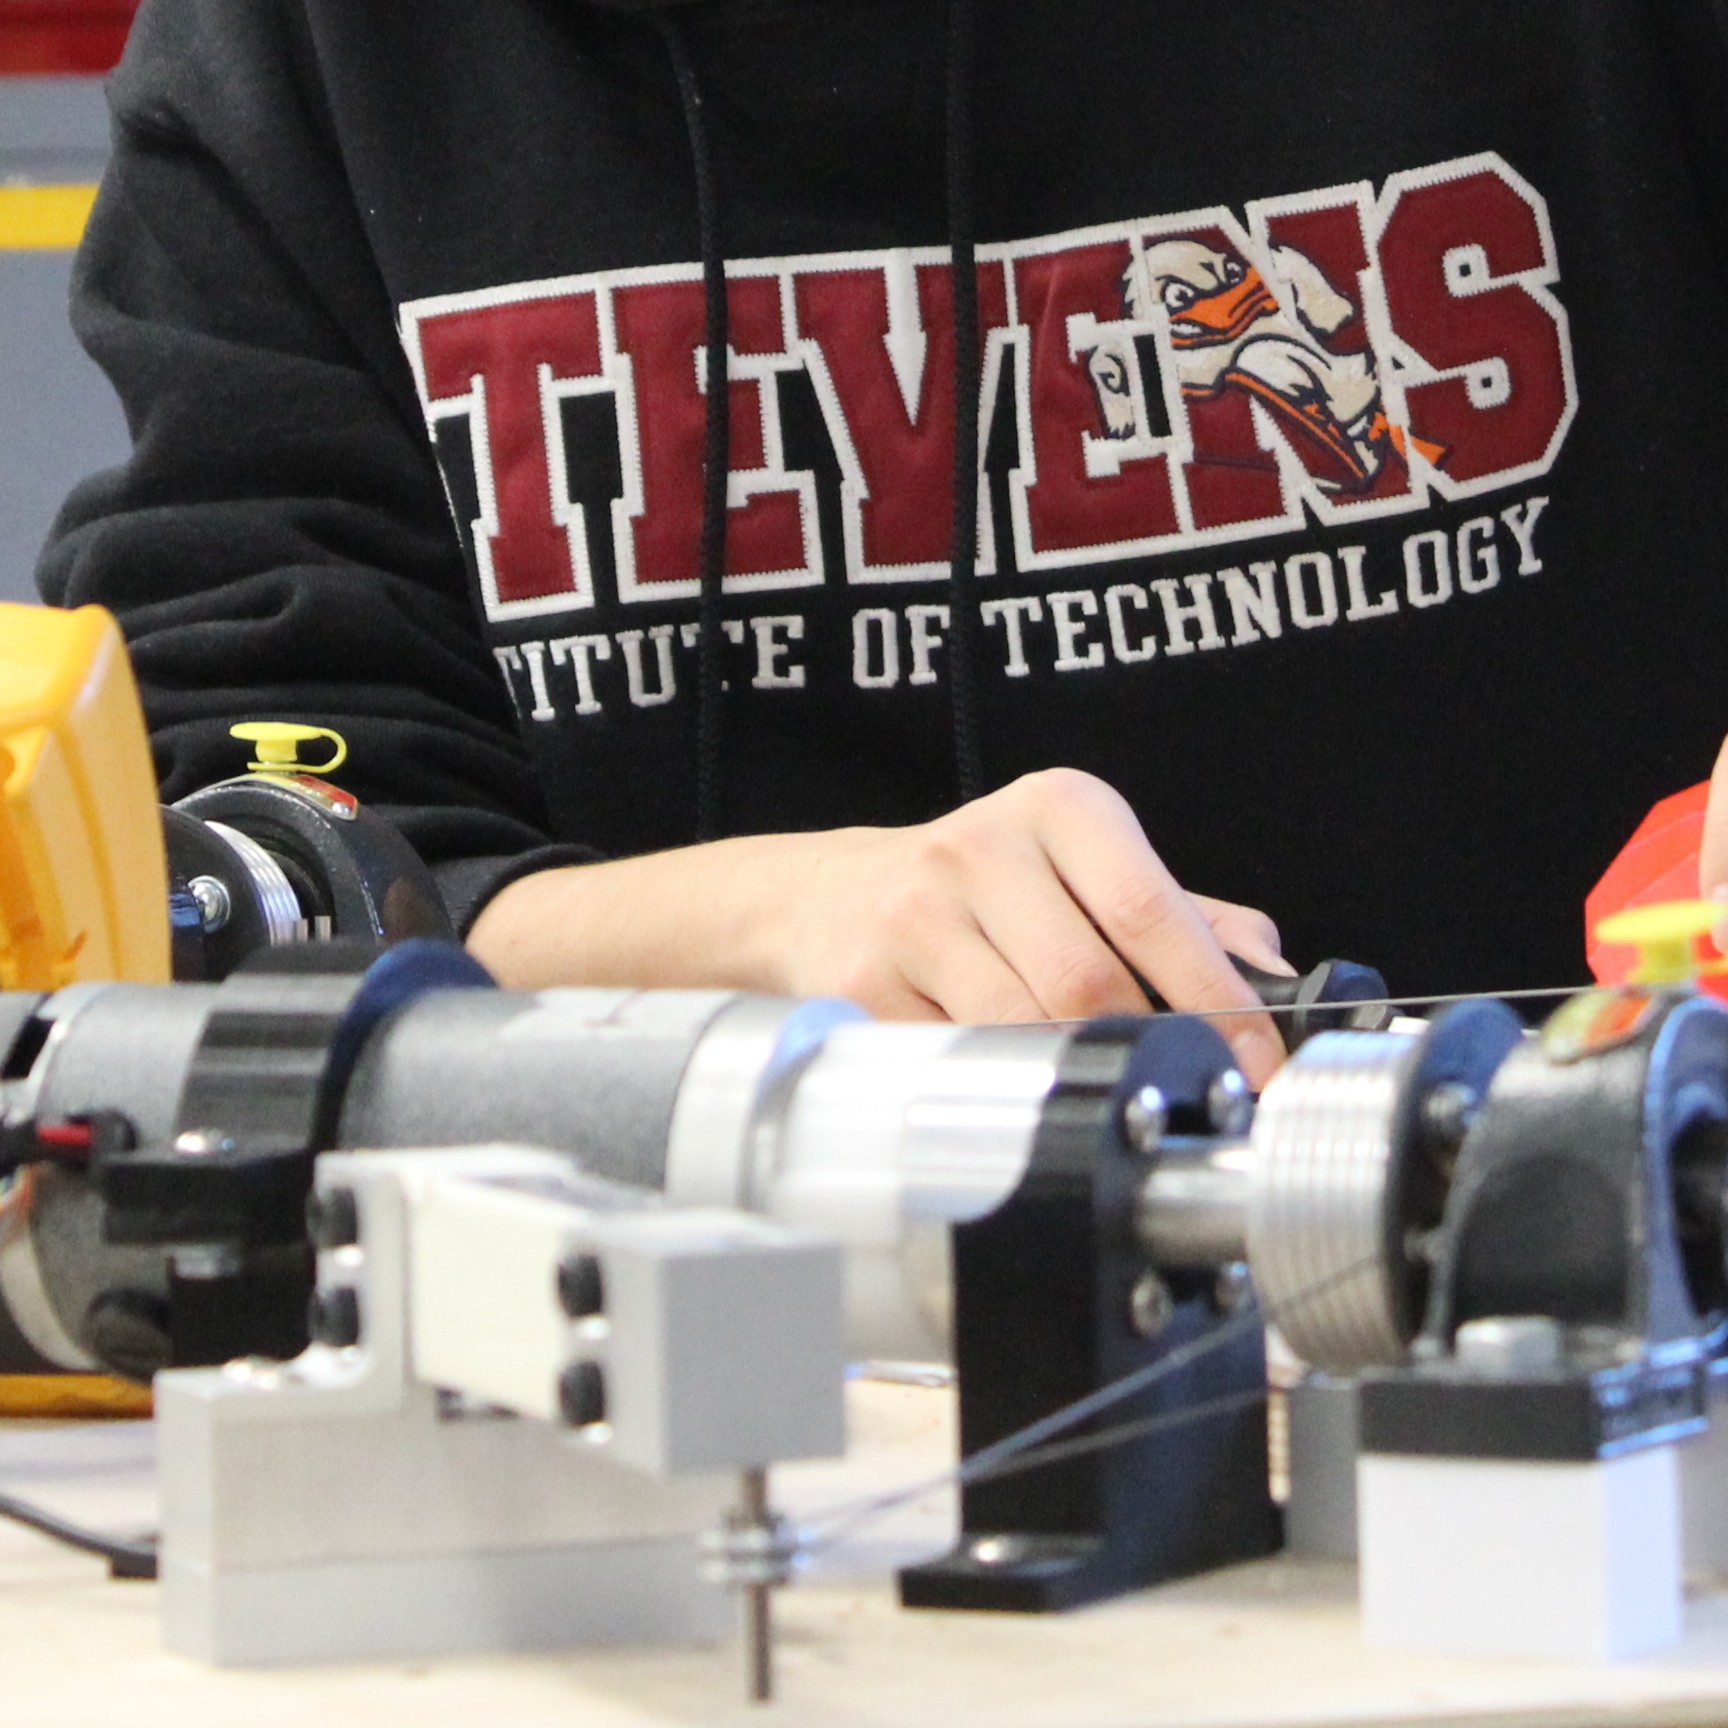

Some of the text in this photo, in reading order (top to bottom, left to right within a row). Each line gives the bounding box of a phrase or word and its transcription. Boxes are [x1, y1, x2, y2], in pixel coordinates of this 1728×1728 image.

[396, 150, 1579, 623] TEVENS
[852, 604, 951, 689] OF
[980, 495, 1549, 678] TECHNOLOGY
